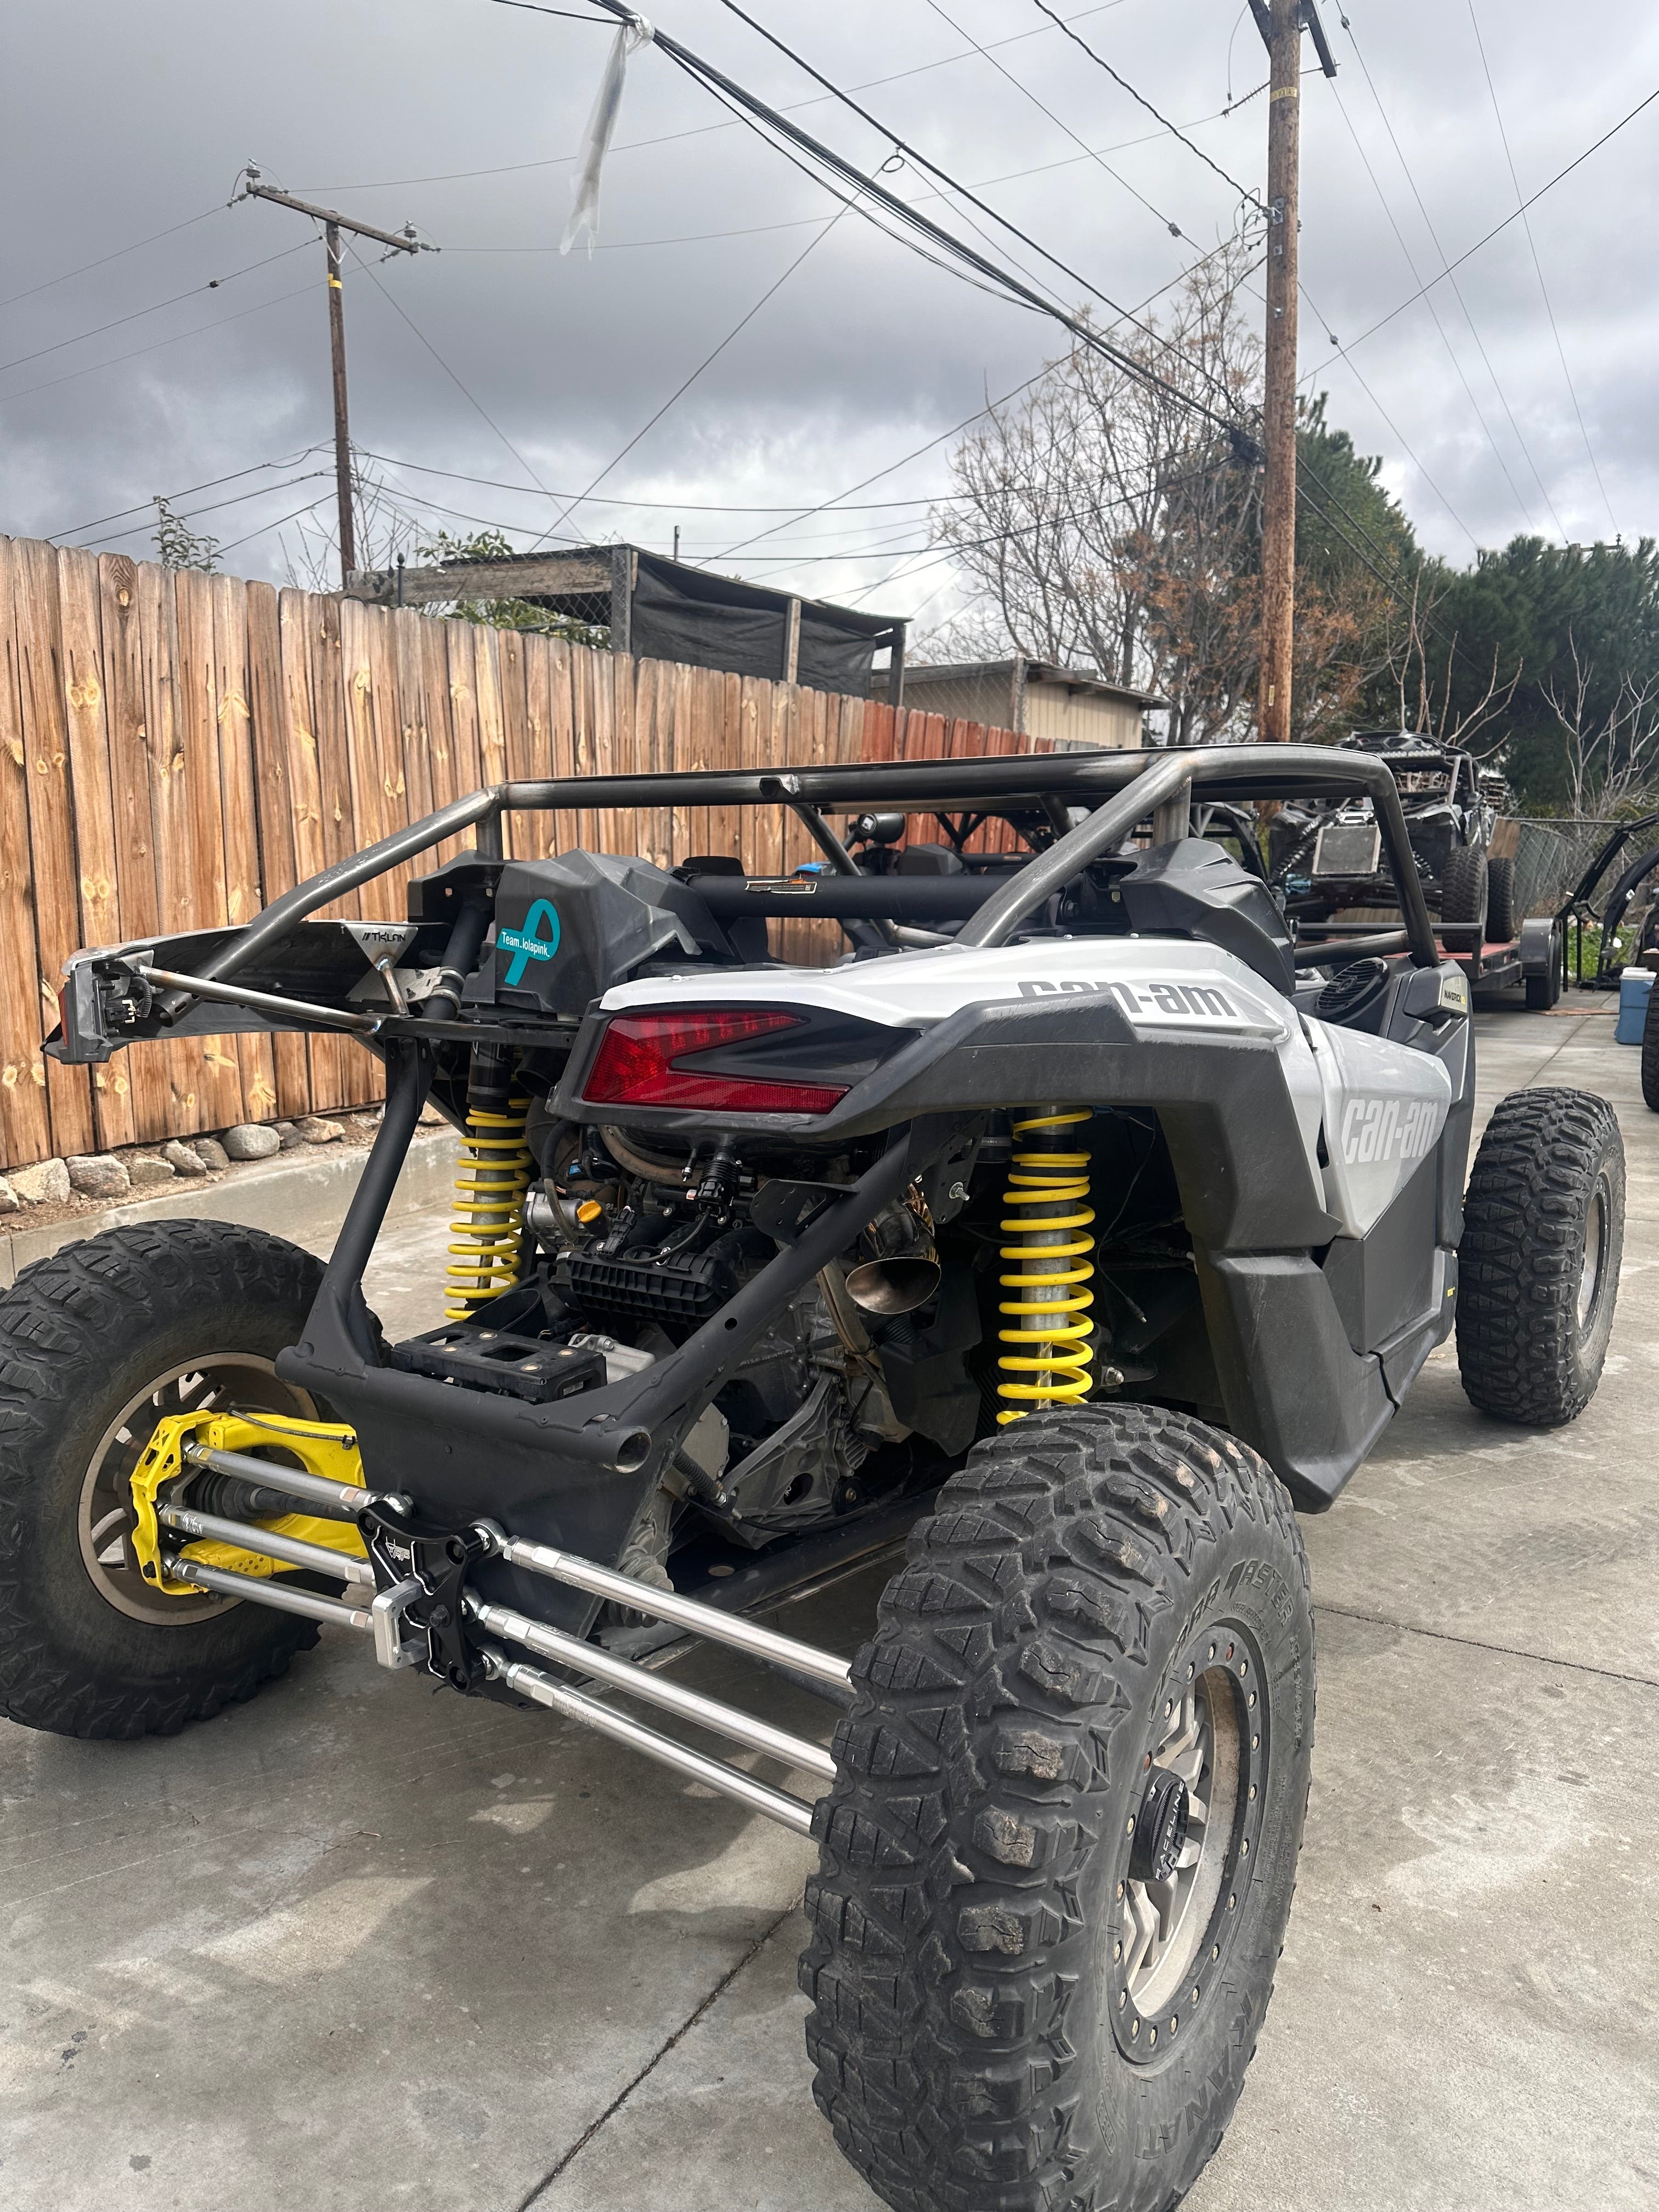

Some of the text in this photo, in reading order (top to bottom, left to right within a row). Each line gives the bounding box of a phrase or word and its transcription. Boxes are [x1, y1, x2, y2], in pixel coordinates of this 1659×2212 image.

[1018, 981, 1237, 1017] n-am
[1341, 1099, 1438, 1164] can-am
[1222, 1559, 1295, 1628] MASTER
[1155, 1781, 1185, 1881] RACELINE
